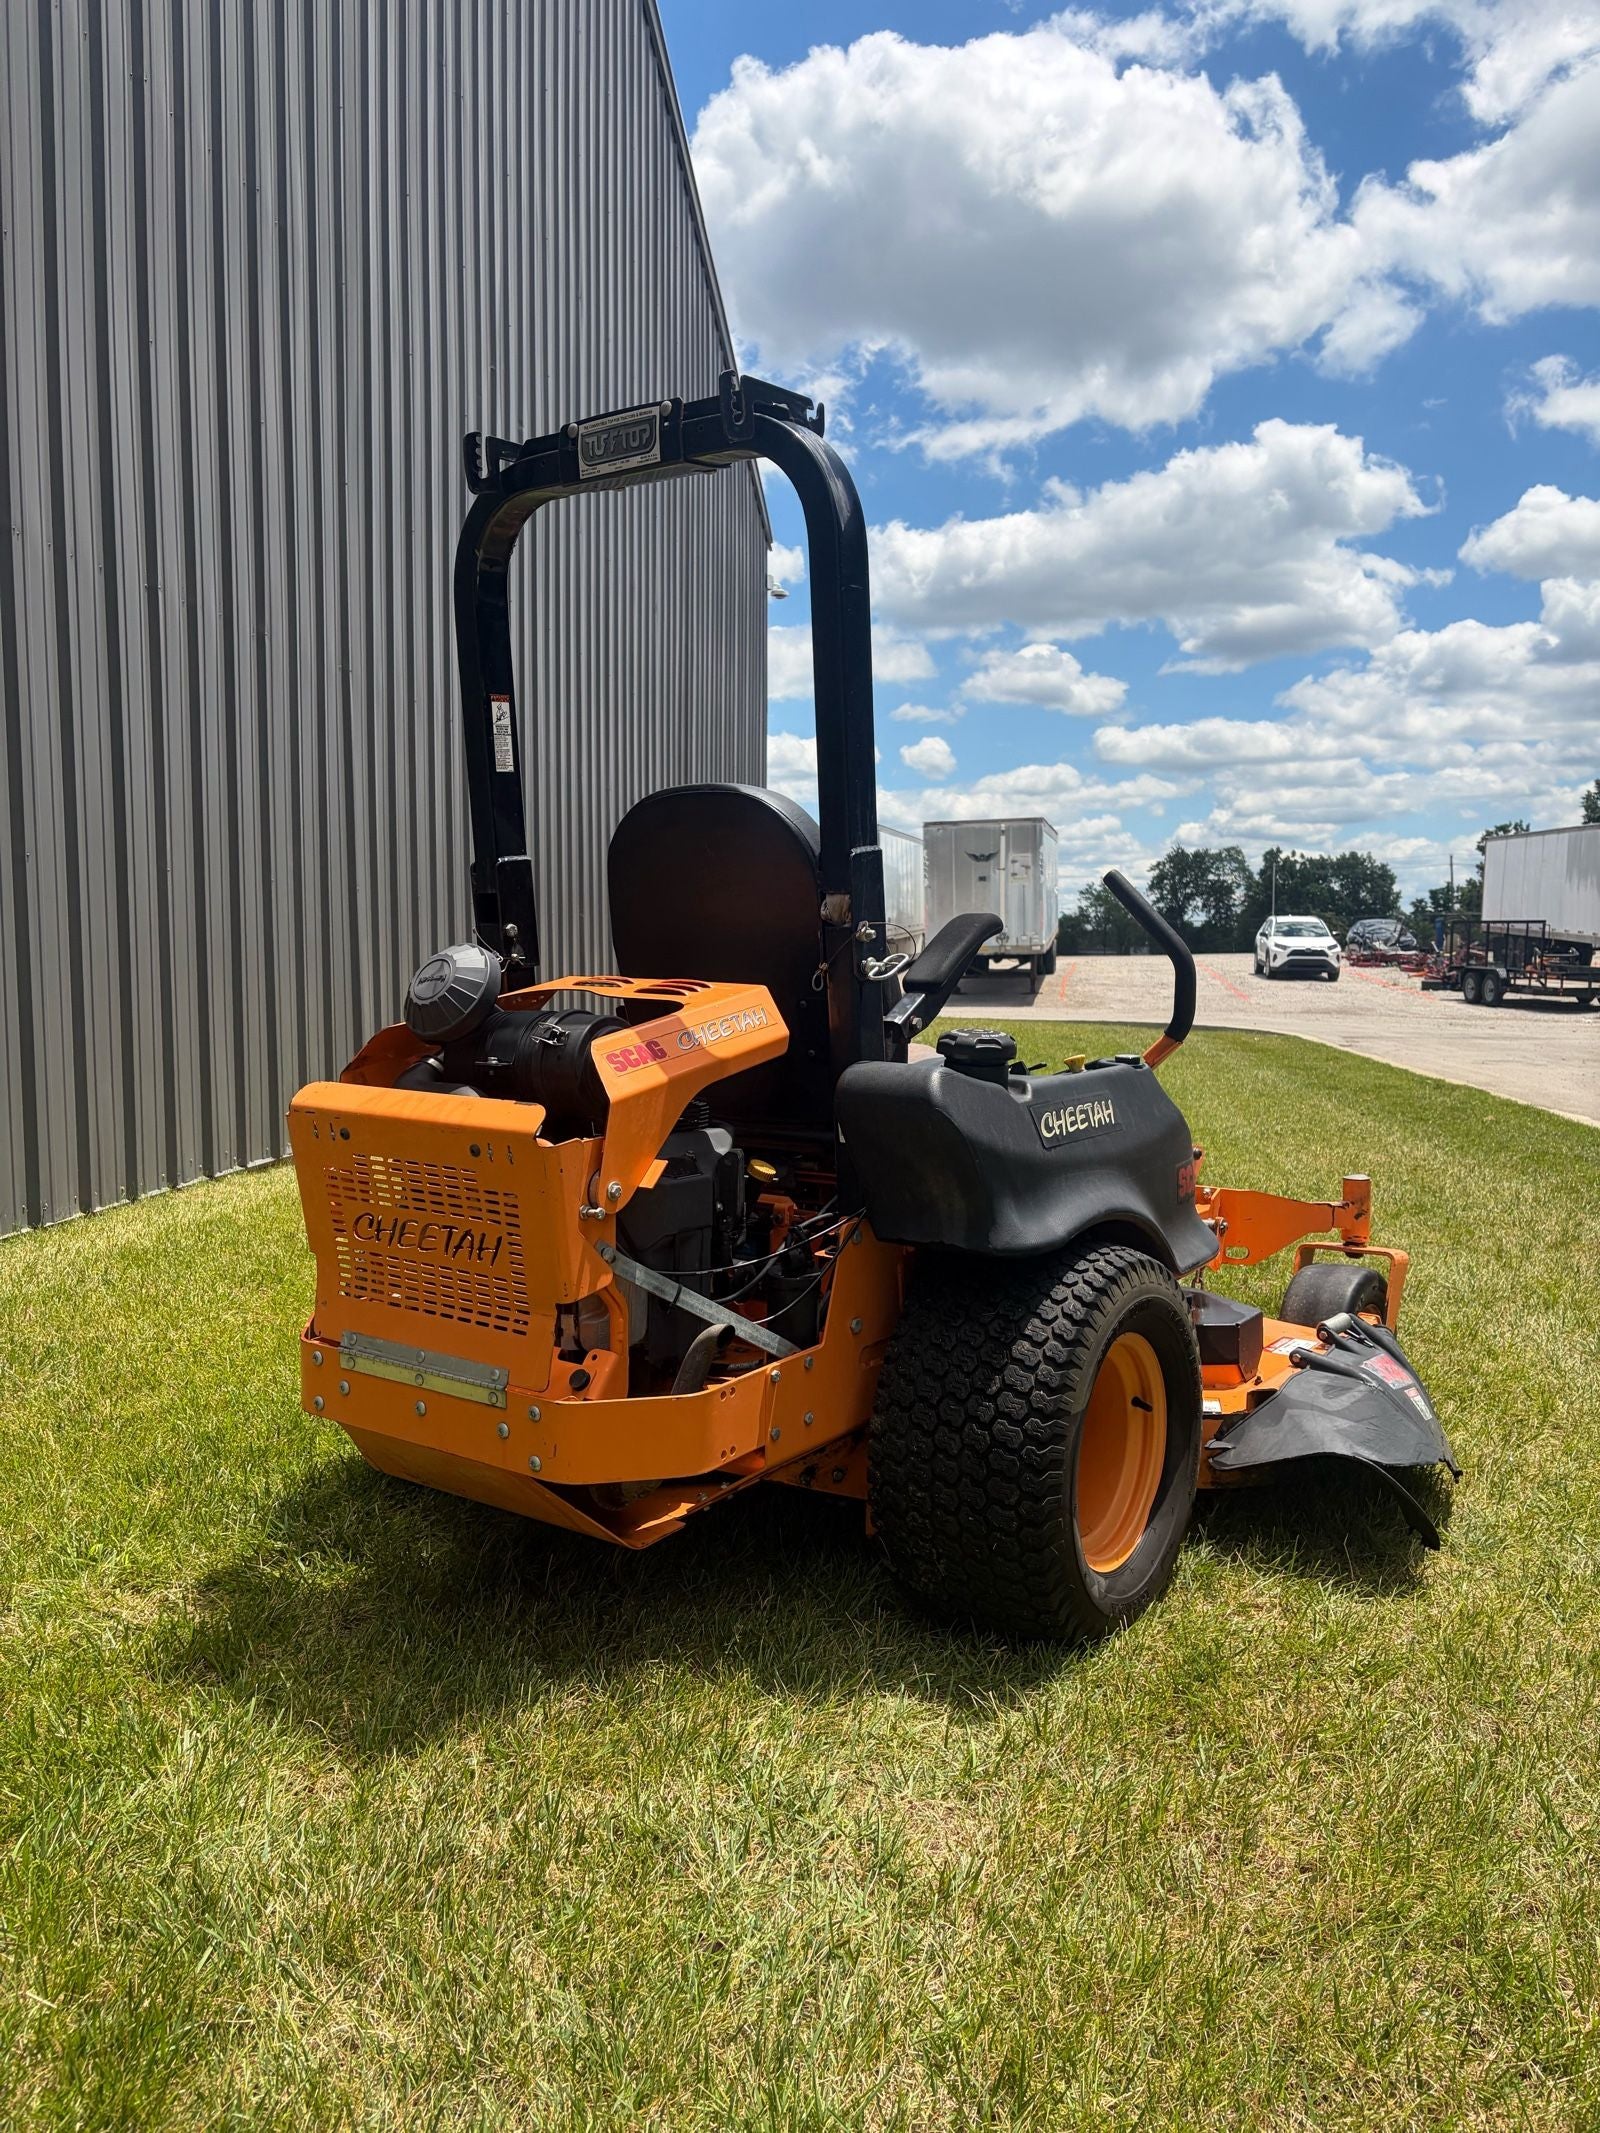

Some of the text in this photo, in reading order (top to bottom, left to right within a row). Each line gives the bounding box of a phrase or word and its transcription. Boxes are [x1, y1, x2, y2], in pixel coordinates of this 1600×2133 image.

[605, 1007, 768, 1073] SCAG CHEETAH
[1041, 1099, 1115, 1138] CHEETAH
[352, 1211, 503, 1268] CHEETAH
